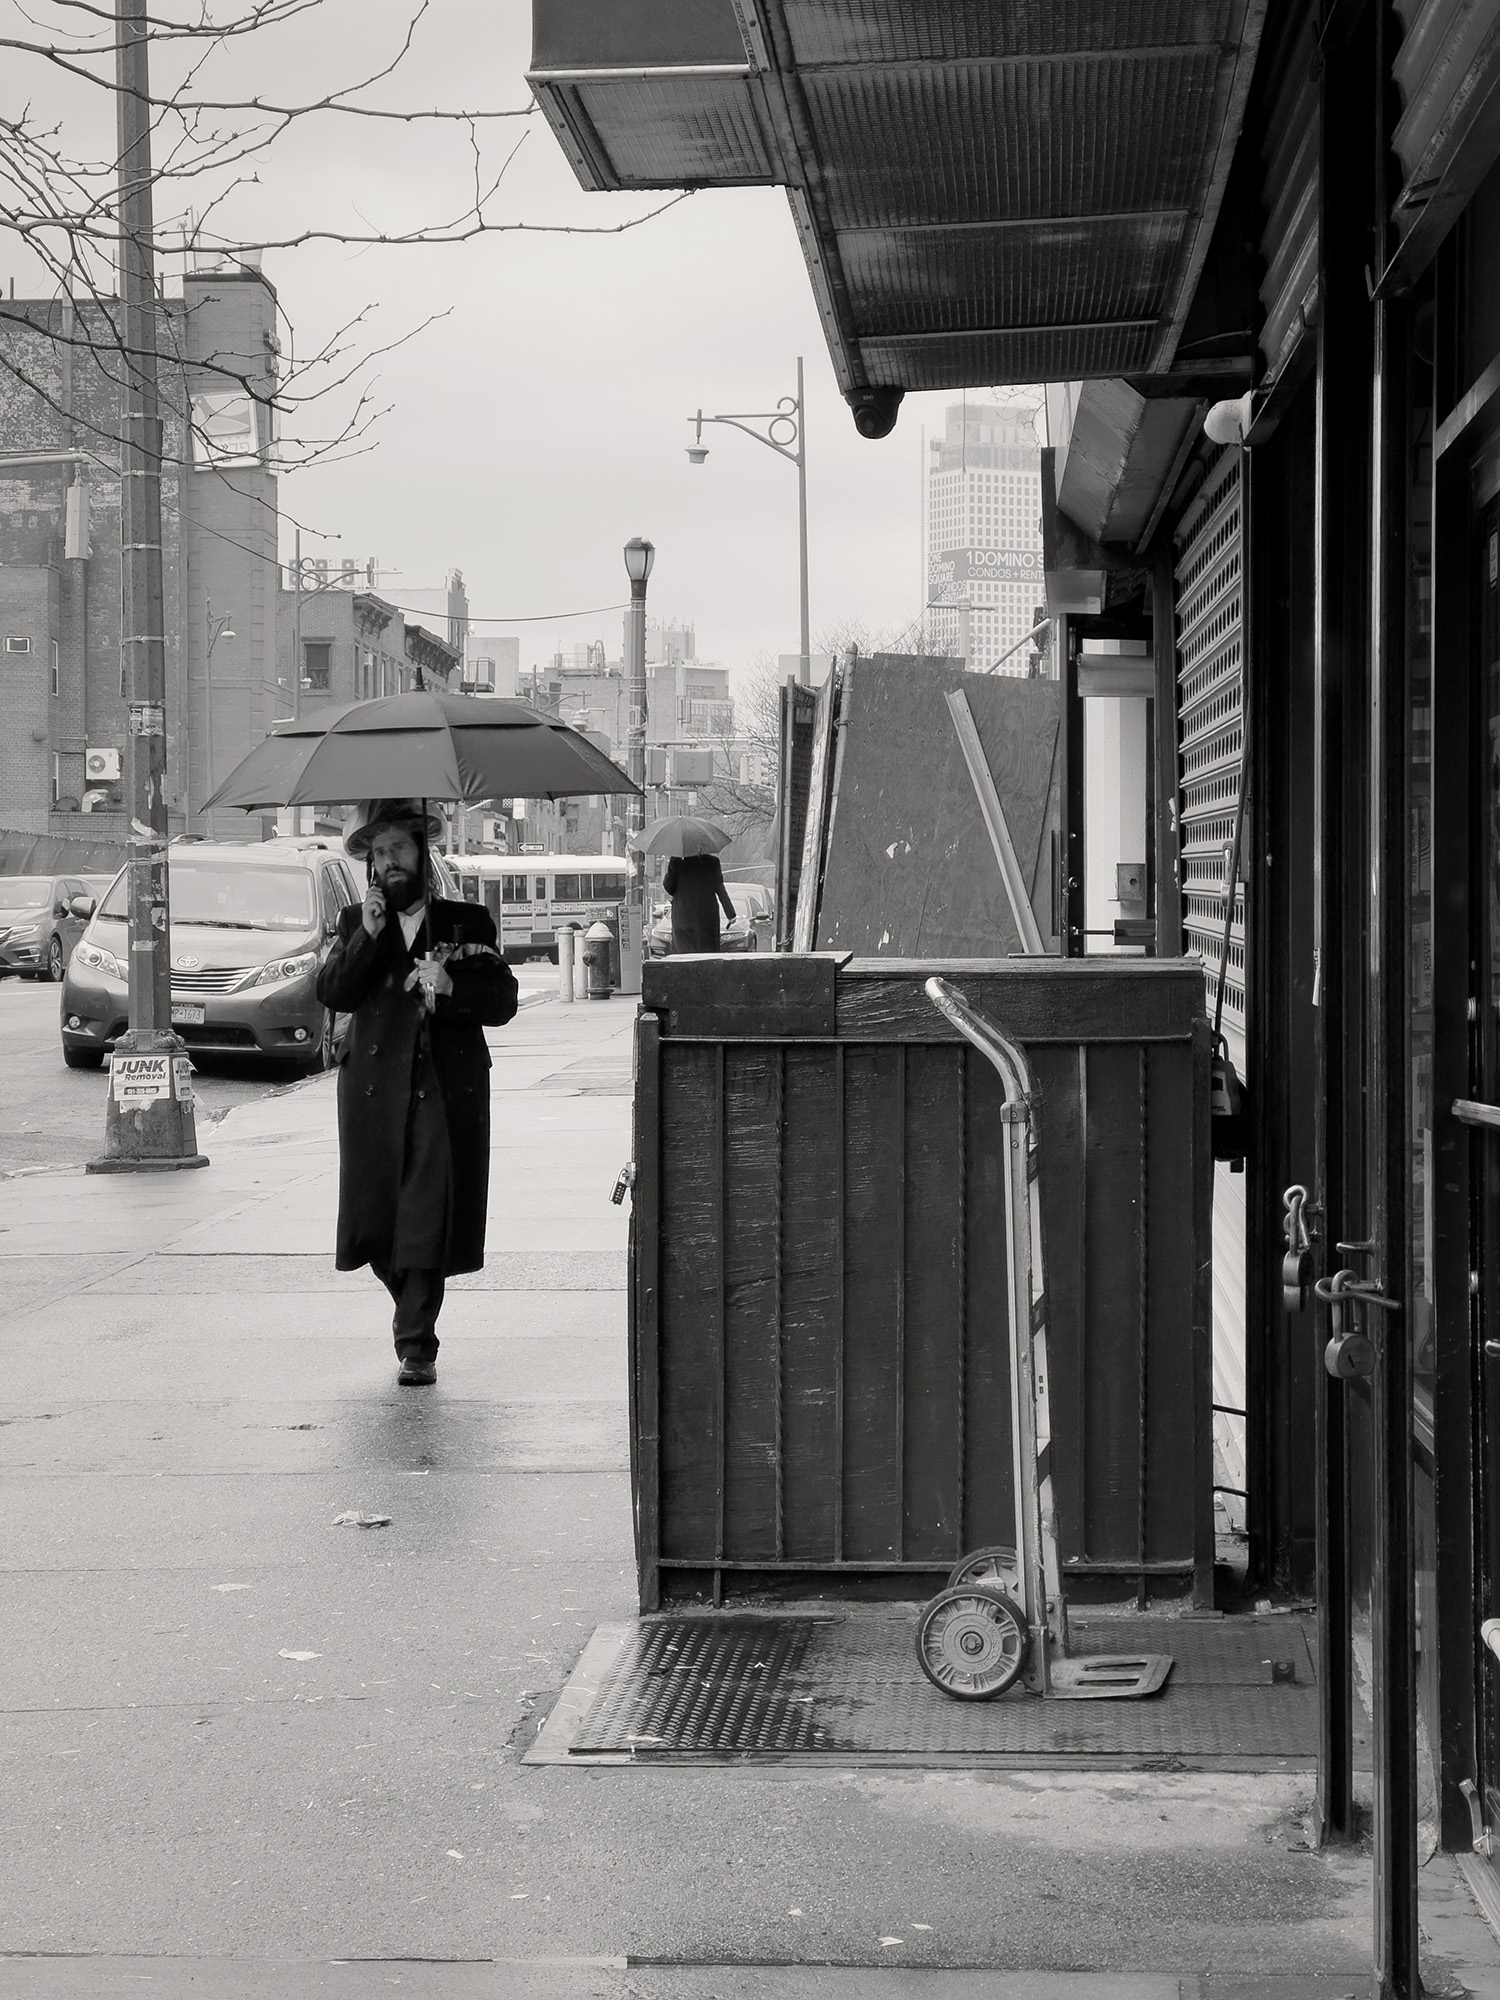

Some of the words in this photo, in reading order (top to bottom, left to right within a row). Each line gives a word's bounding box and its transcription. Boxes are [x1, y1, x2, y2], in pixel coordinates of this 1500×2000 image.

[928, 552, 942, 564] ONE
[975, 551, 1034, 567] DOMINO
[928, 561, 955, 575] DOMINO
[968, 566, 1011, 579] CONDOS
[928, 571, 954, 585] SQUARE
[937, 579, 966, 594] CONDOS
[116, 1060, 166, 1075] JUNK
[124, 1072, 167, 1081] Removal
